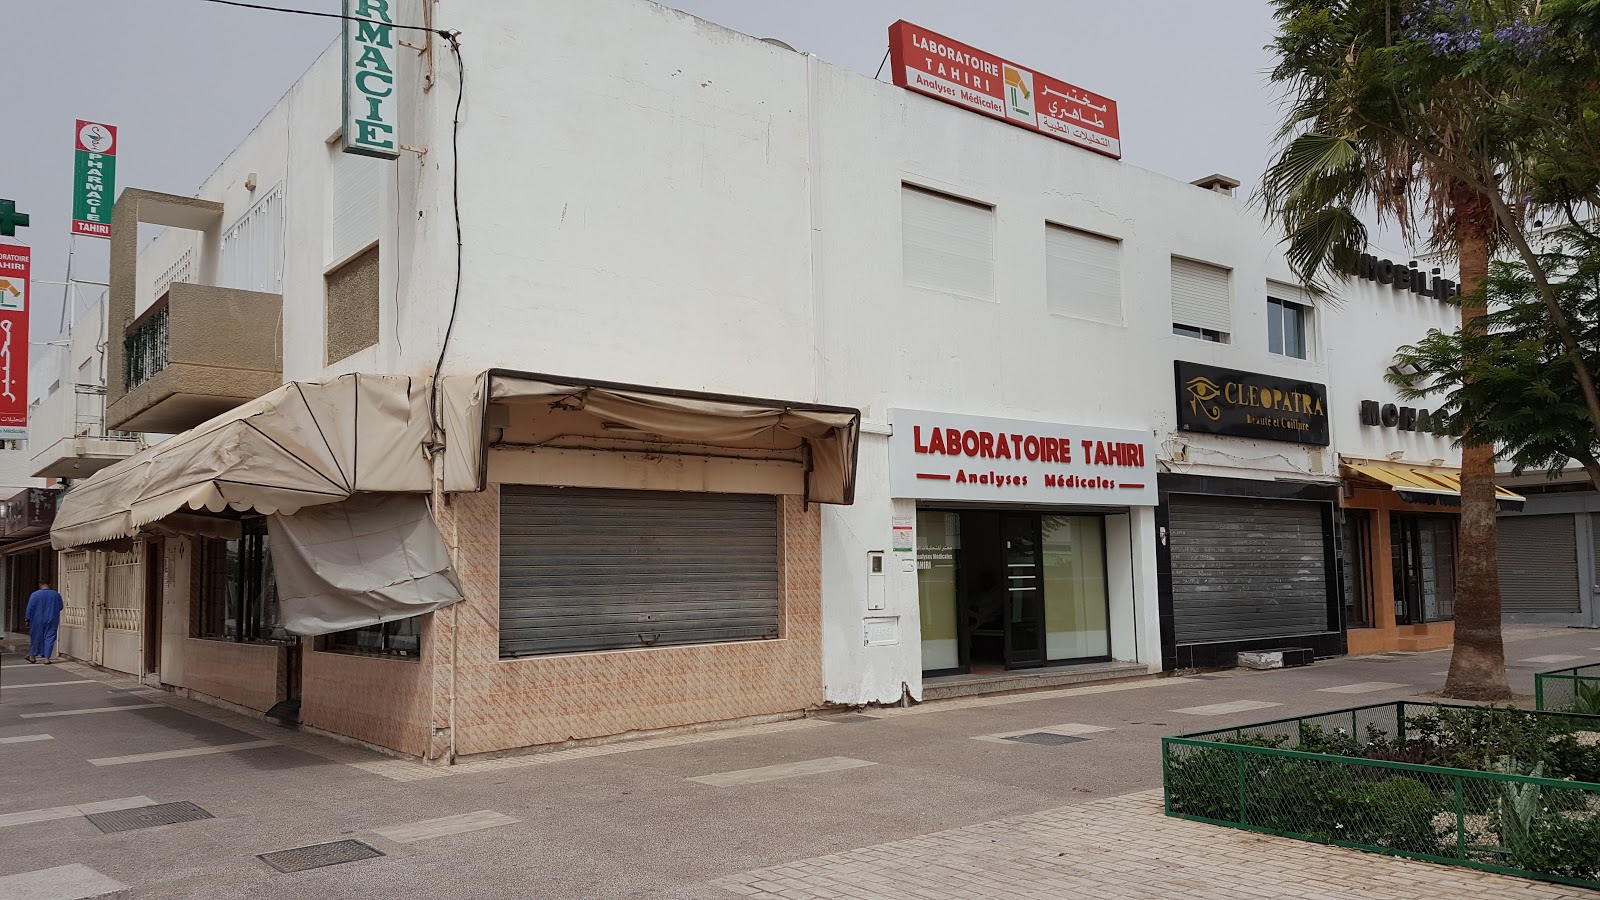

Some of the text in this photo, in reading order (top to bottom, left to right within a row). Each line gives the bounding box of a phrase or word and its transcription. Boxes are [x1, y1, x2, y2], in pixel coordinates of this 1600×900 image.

[912, 33, 999, 77] LABORATOIRE
[916, 73, 1002, 112] Analyses Médicales
[925, 57, 990, 92] TAHIRI
[86, 152, 103, 222] PHARMACIE
[78, 222, 109, 234] TAHIRI
[1224, 382, 1324, 416] CLEOPATRA
[913, 425, 1145, 468] LABORATOIRE TAHIRI
[955, 469, 1115, 490] Analyses Médicales
